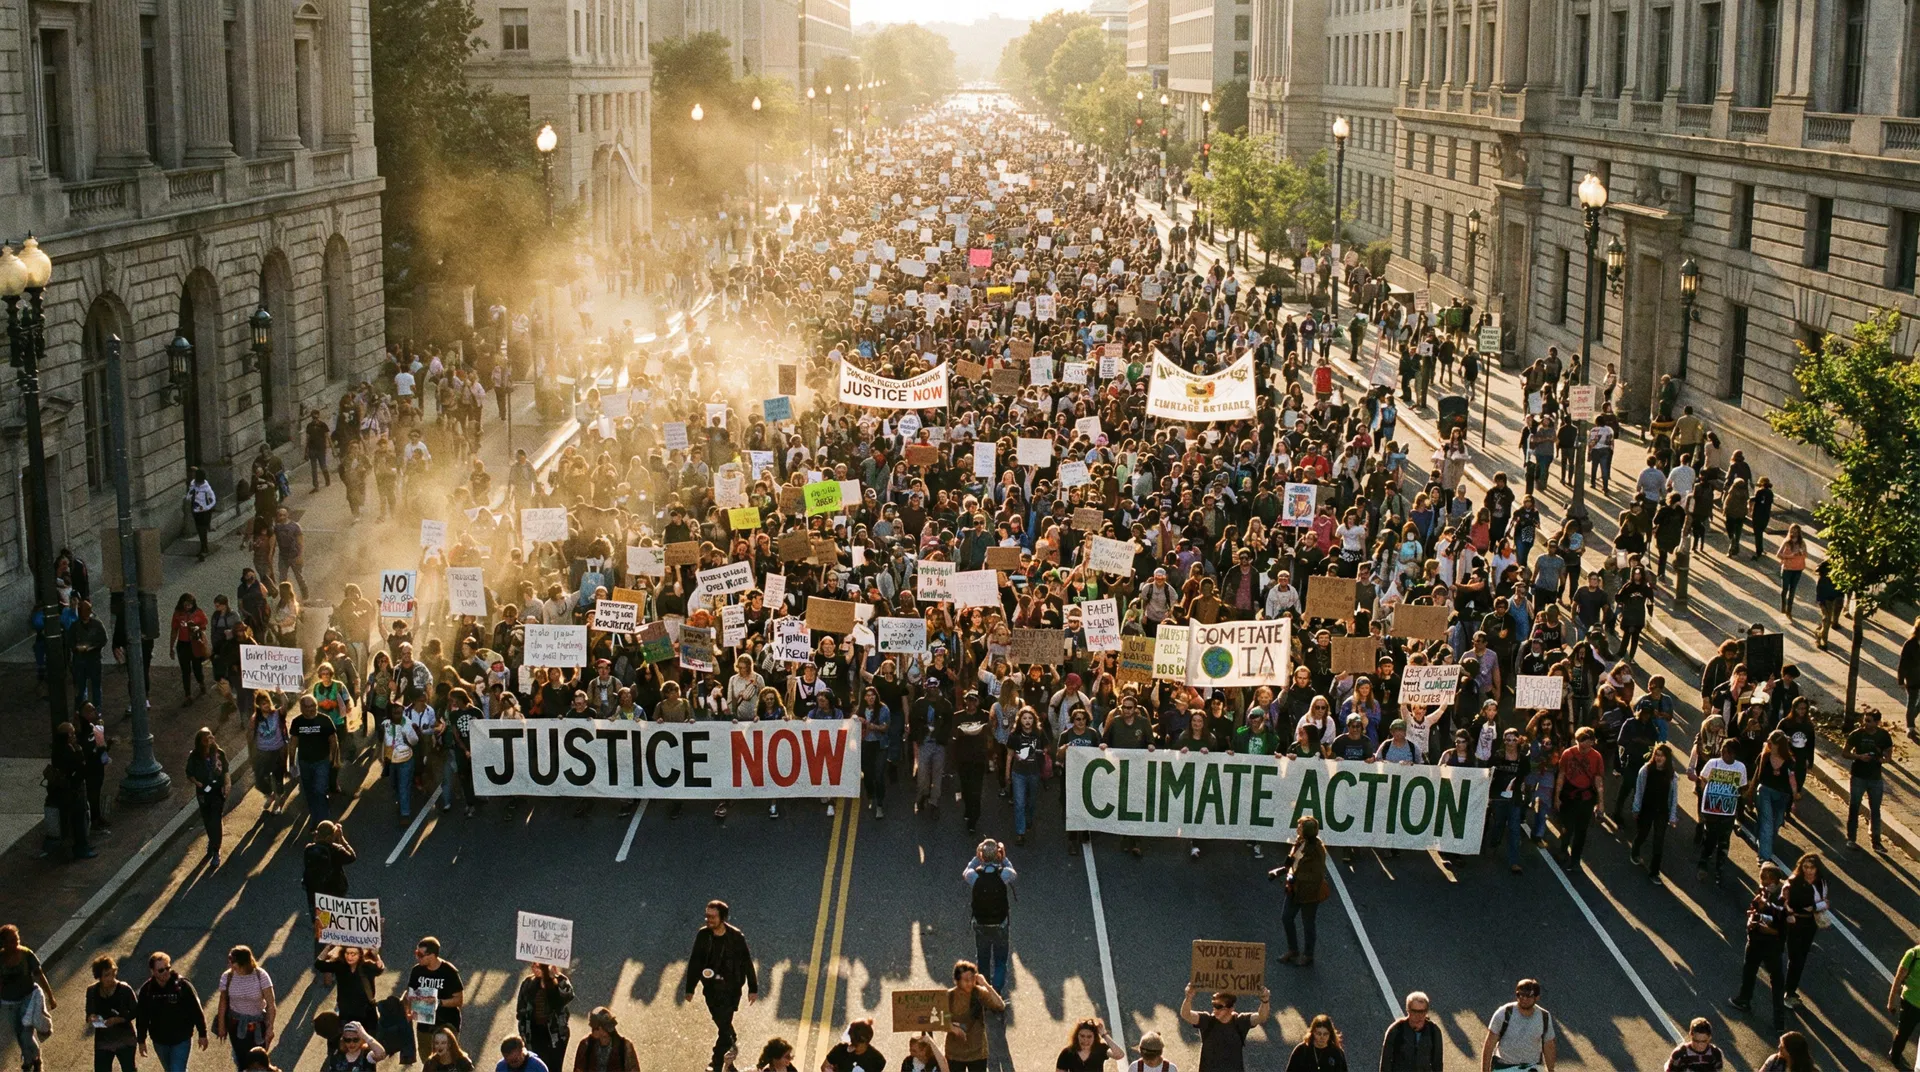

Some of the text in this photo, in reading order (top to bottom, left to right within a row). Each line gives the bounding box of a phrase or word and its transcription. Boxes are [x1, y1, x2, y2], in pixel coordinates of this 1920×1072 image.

[844, 381, 943, 402] JUSTICE NOW
[383, 574, 407, 593] NO
[484, 728, 848, 788] JUSTICE NOW
[1082, 758, 1471, 840] CLIMATE ACTION
[318, 896, 369, 915] CLIMATE
[329, 912, 379, 932] ACTION
